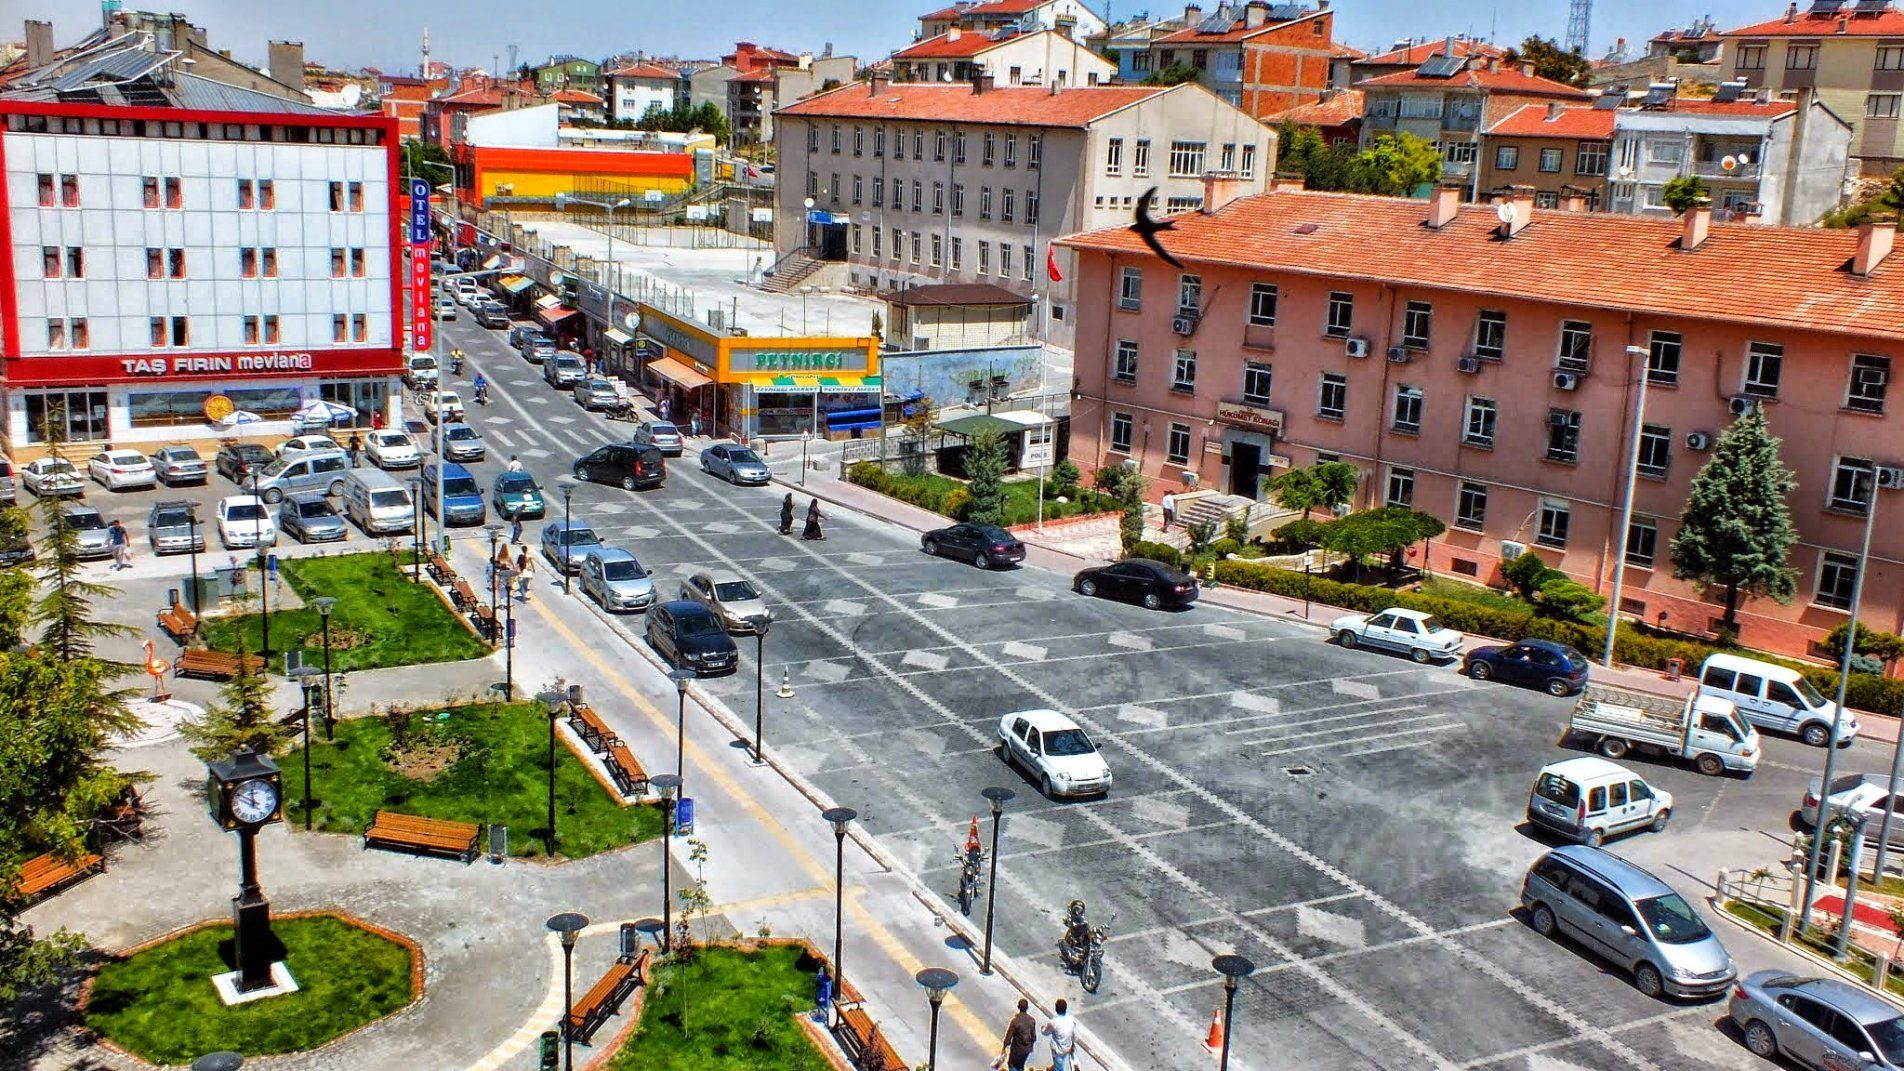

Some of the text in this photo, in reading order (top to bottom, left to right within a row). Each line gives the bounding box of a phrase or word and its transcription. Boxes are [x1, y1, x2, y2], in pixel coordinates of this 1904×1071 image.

[415, 184, 426, 241] OTEL
[415, 249, 427, 346] mevlana
[121, 352, 312, 375] TAŞ FIRIN mevlana
